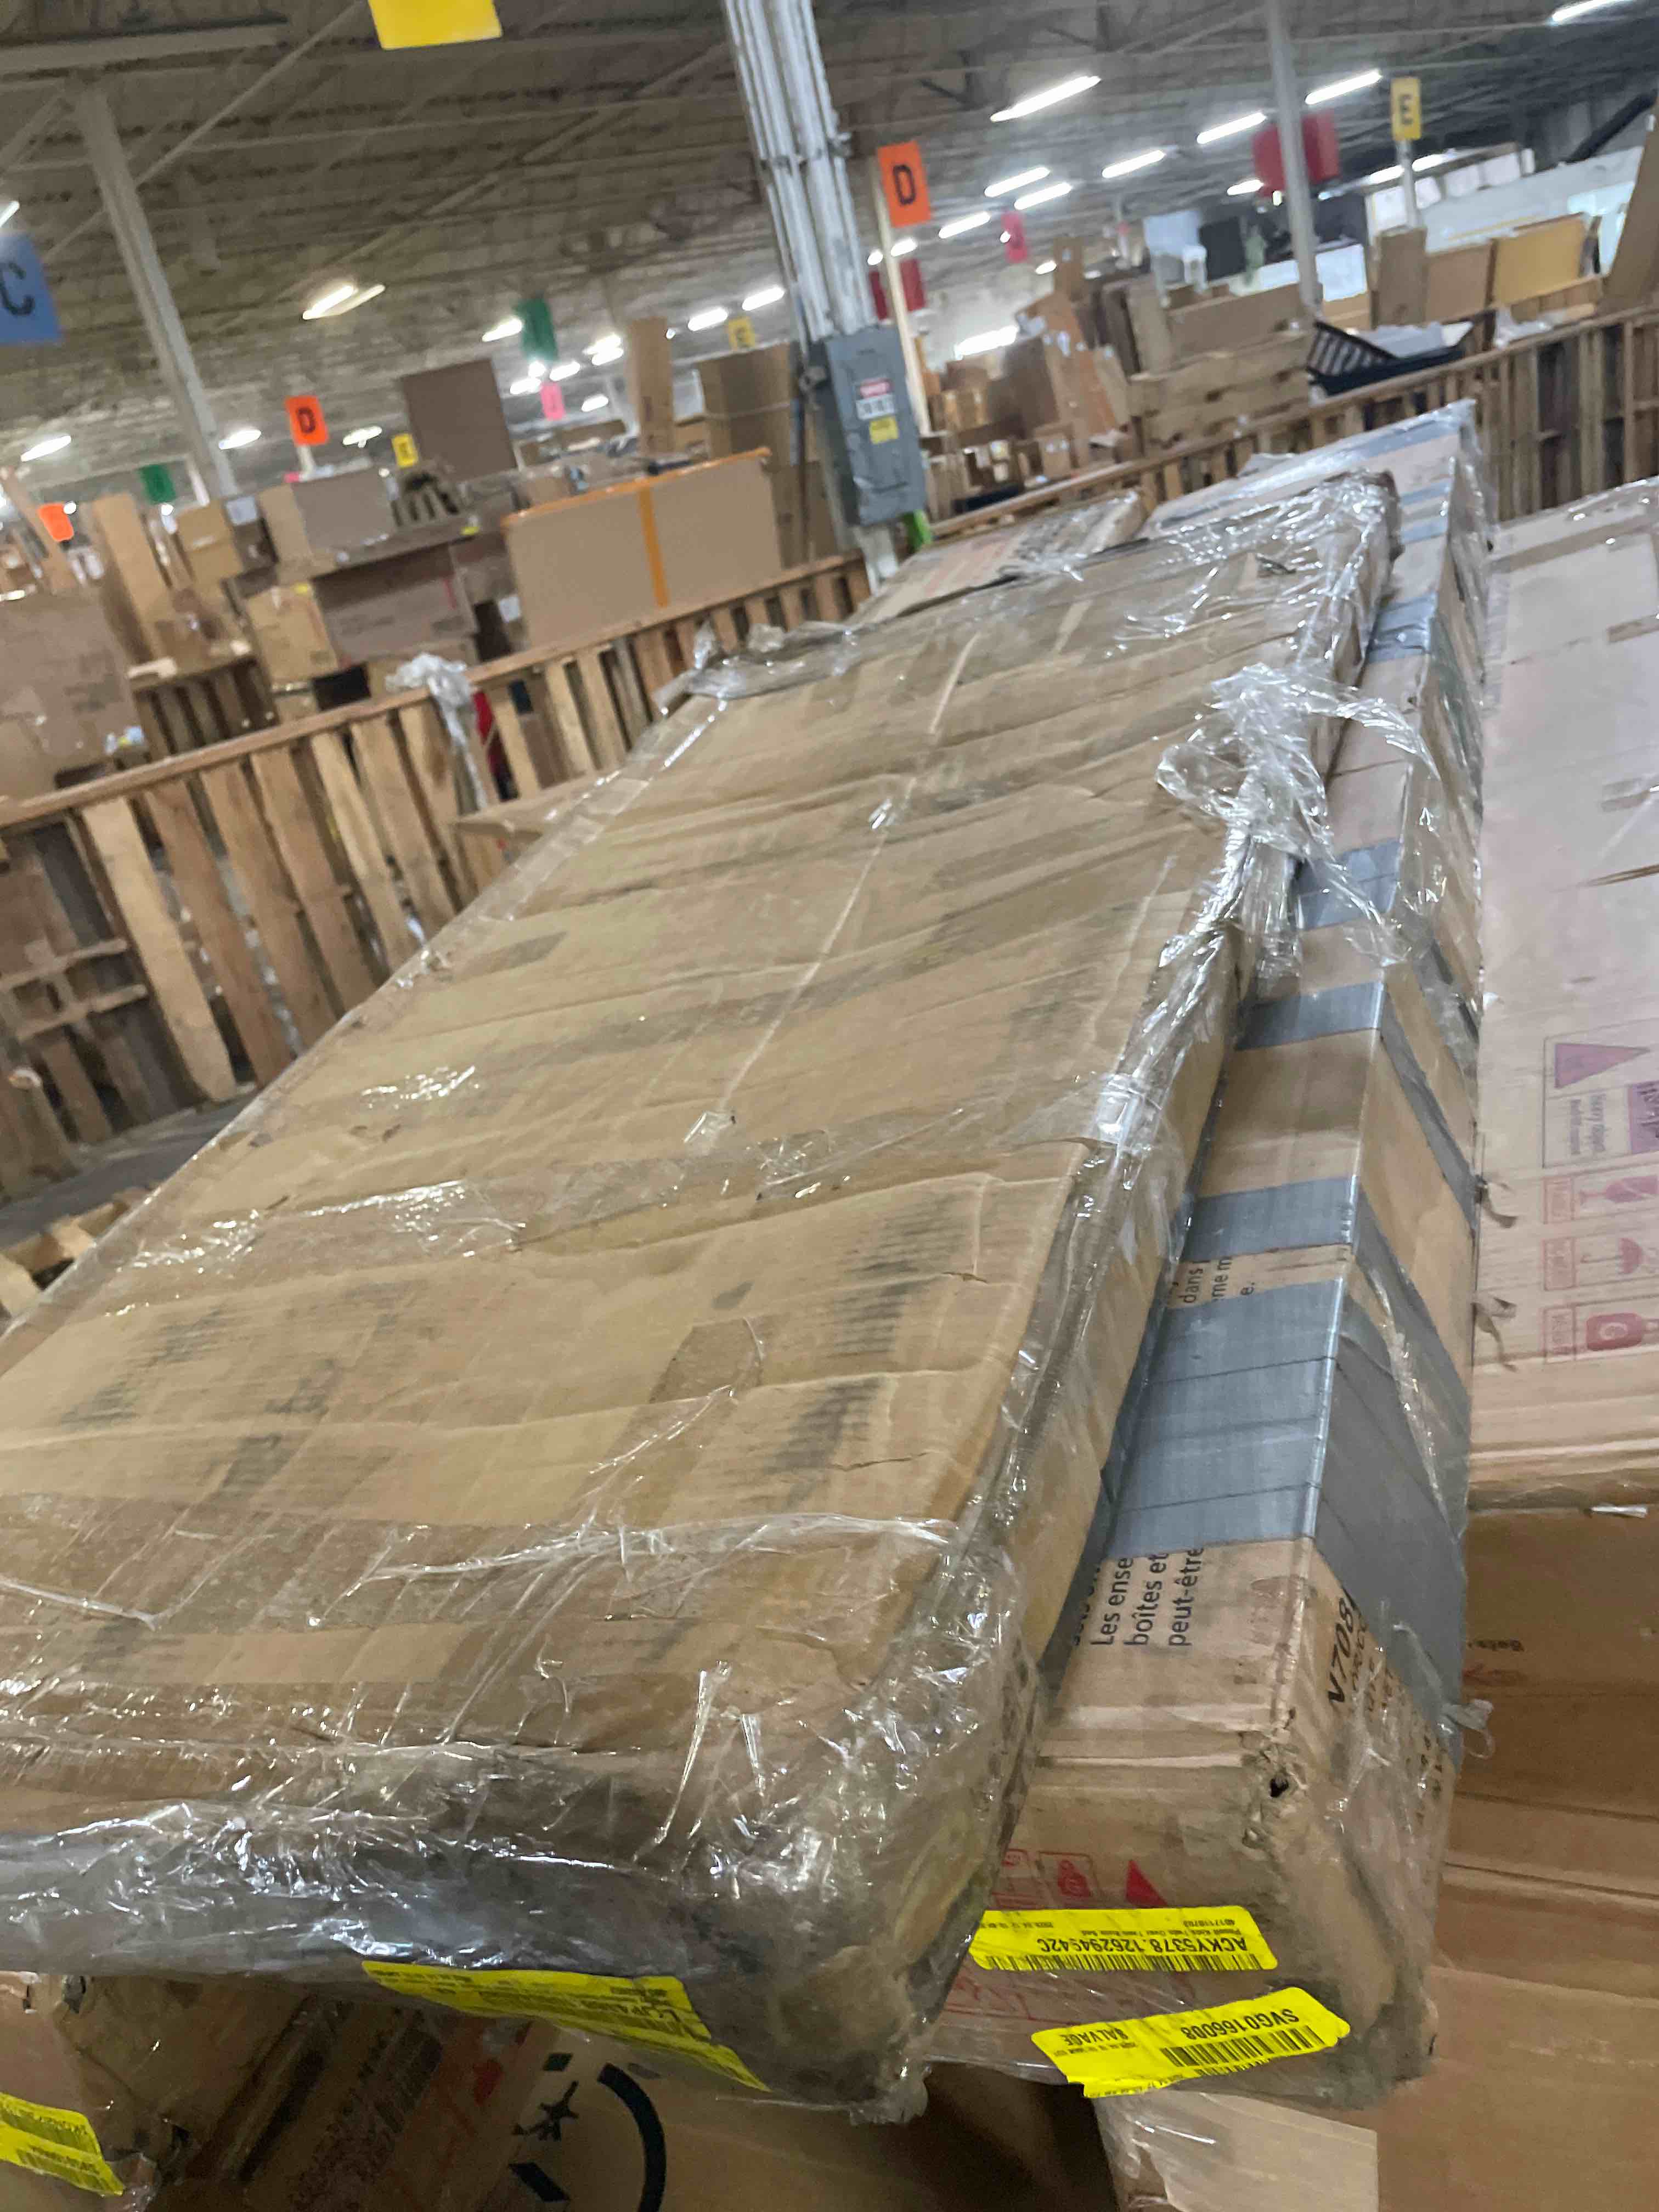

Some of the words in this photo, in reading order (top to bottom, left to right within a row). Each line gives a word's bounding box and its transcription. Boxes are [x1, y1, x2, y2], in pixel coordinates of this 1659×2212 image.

[1398, 94, 1414, 125] E
[893, 164, 917, 206] D
[0, 262, 35, 316] C
[296, 407, 317, 433] D
[1090, 1612, 1120, 1645] Les
[1108, 1558, 1134, 1606] ense
[1179, 1268, 1203, 1303] dans
[1124, 1580, 1163, 1645] boîtes
[1168, 1548, 1204, 1646] peut-être
[1181, 2008, 1299, 2040] SVG0166008
